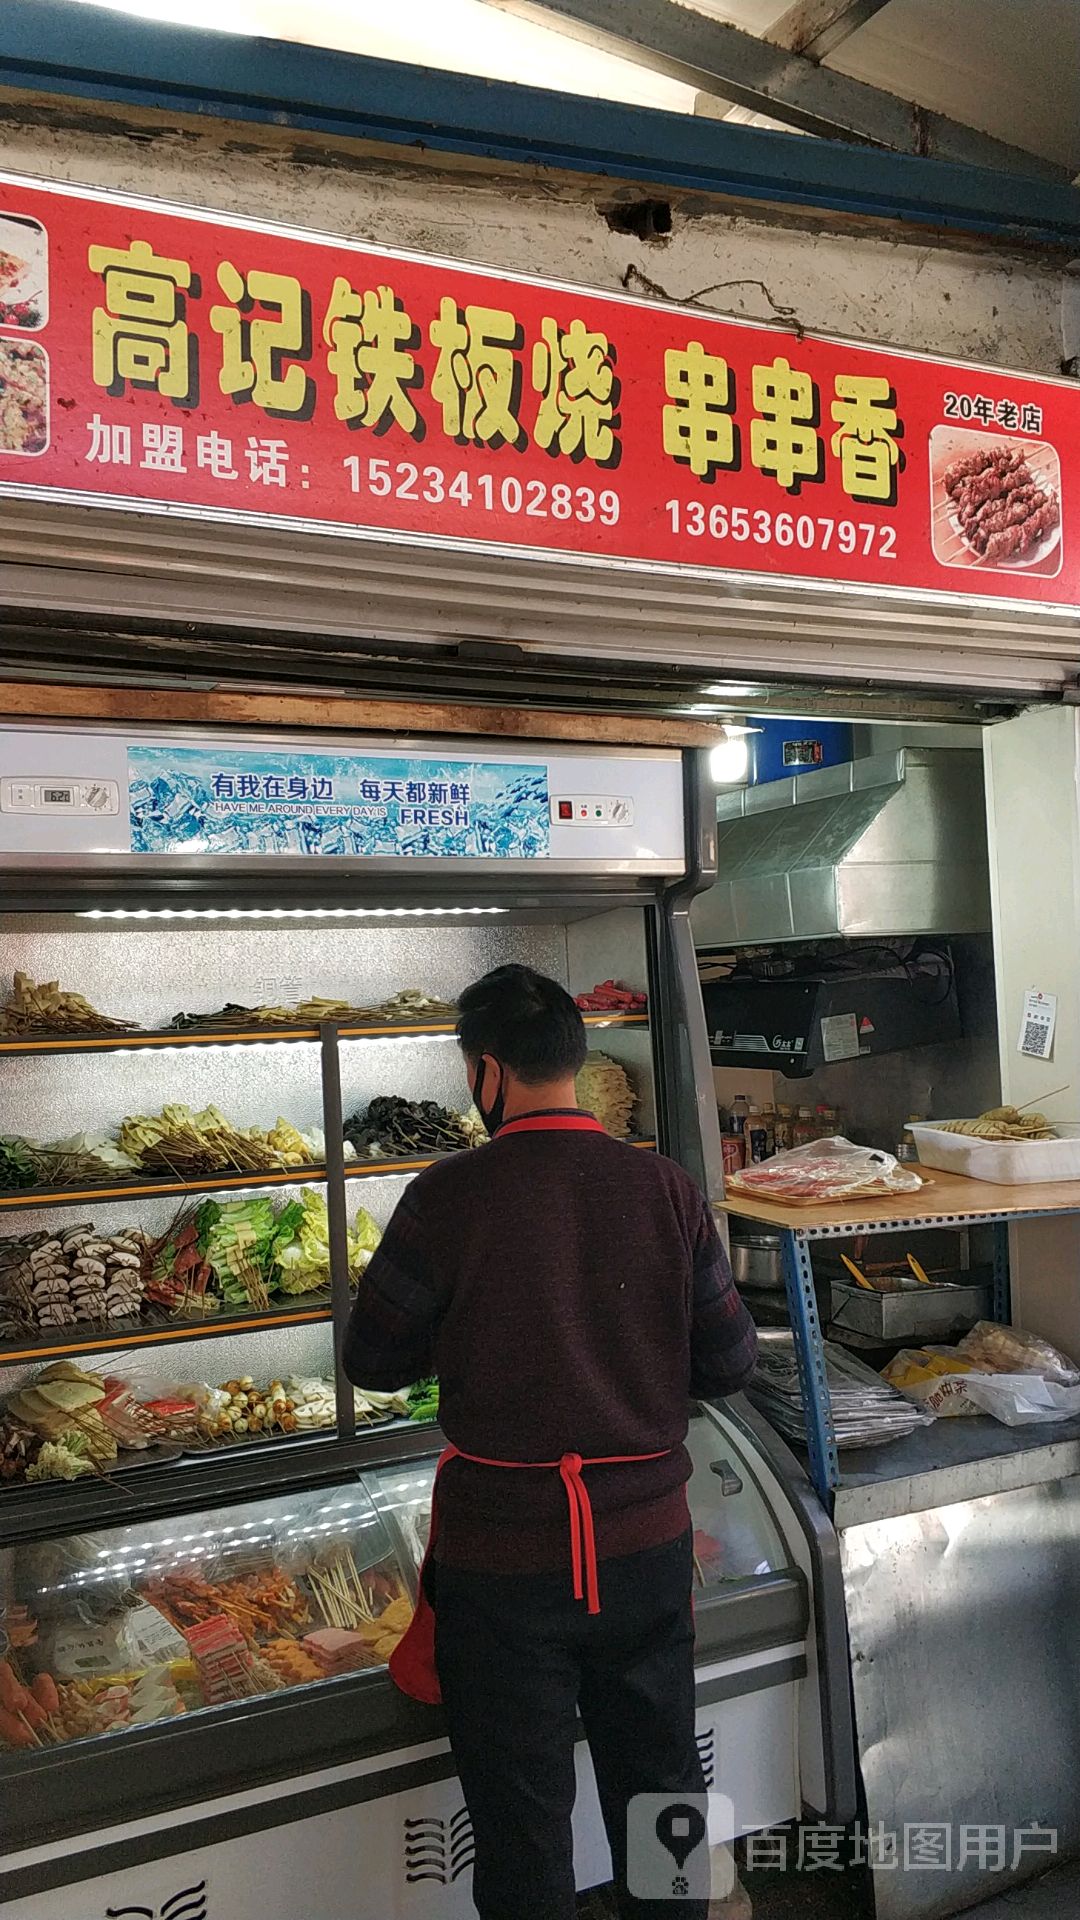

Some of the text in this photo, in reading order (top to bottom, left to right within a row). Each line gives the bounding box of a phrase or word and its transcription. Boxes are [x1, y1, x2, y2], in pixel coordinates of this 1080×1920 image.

[88, 240, 900, 502] 高记铁板烧 串串香
[944, 393, 1042, 434] 20年老店
[343, 455, 621, 527] 15234102839
[665, 499, 898, 559] 13653607972
[212, 773, 471, 806] 有我在身边 每天都新鲜
[215, 802, 246, 812] HAVE
[248, 803, 265, 813] ME
[267, 804, 313, 815] AROUND
[315, 805, 350, 815] EVERY
[353, 807, 374, 816] DAY
[401, 808, 468, 826] FRESH
